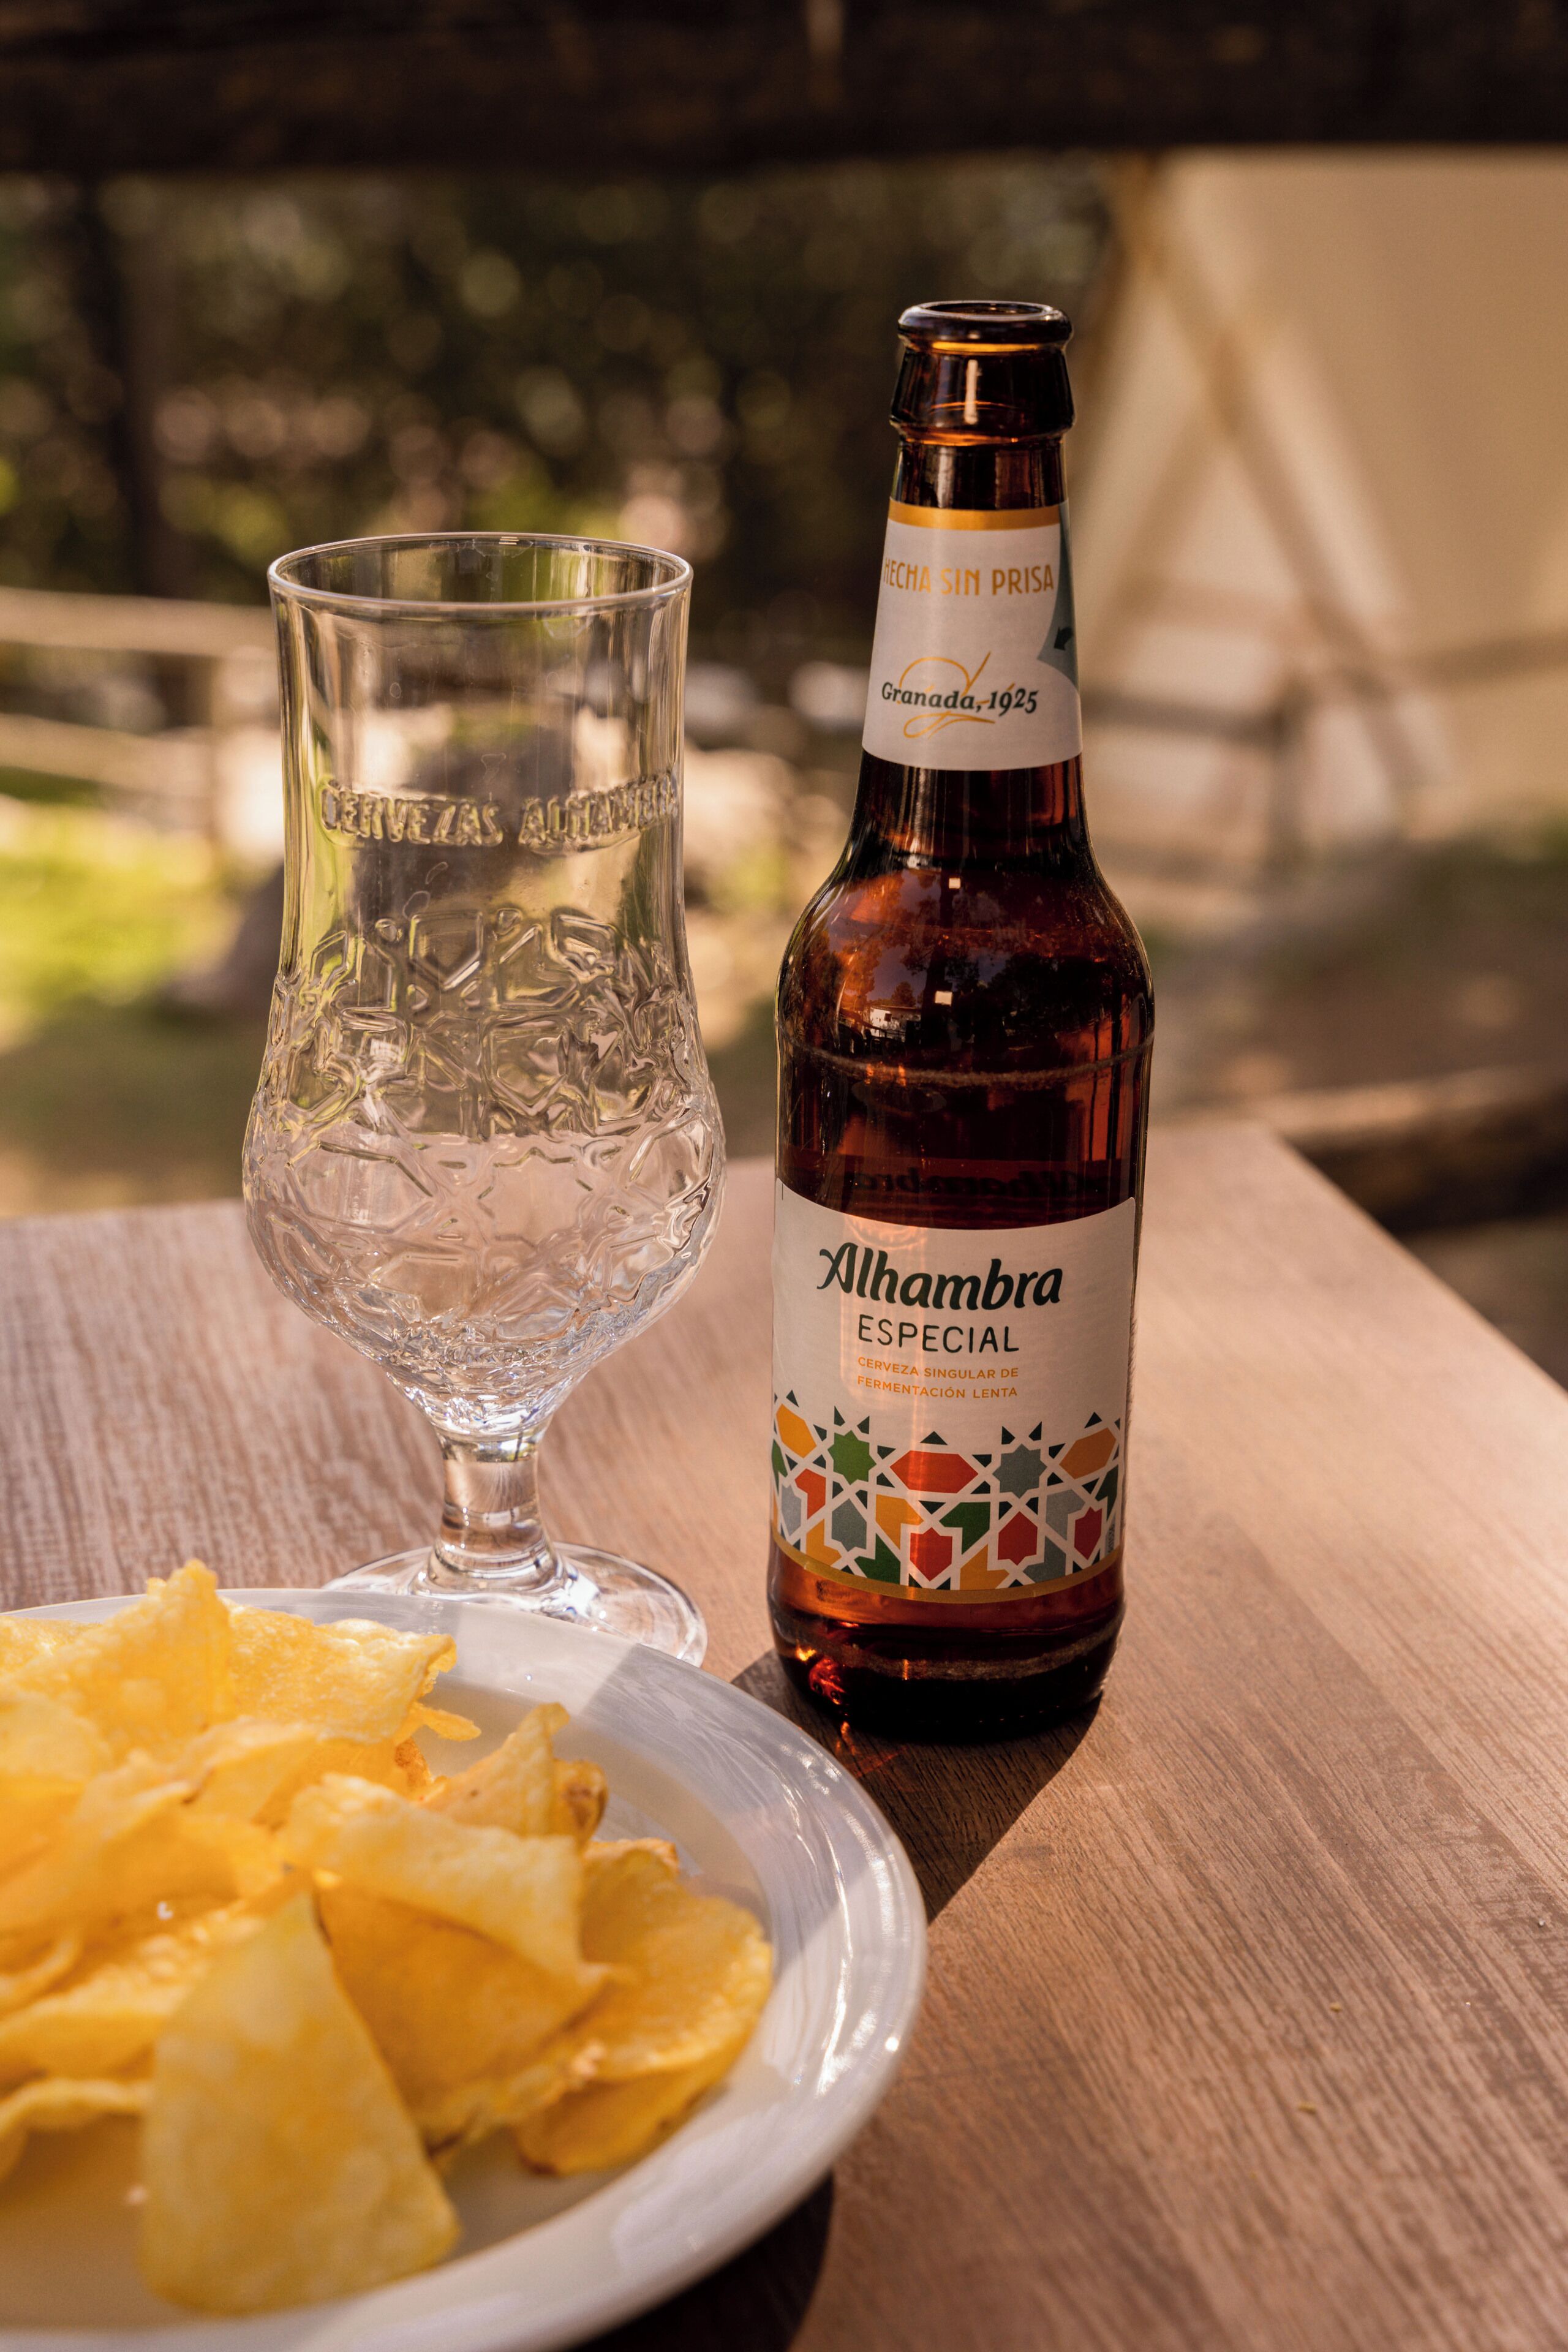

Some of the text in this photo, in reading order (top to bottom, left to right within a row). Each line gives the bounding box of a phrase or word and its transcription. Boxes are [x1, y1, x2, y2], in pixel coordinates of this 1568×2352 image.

[884, 558, 1054, 596] HECHA SIN PRISA
[881, 682, 1039, 717] Granada, 1925
[322, 784, 503, 846] CERVEZAS
[817, 1242, 1063, 1310] Alhambra
[858, 1314, 1019, 1353] ESPECIAL
[858, 1356, 1019, 1379] CERVEZA SINGULAR DE
[858, 1376, 1018, 1398] FERMENTACIÓN LENTA
